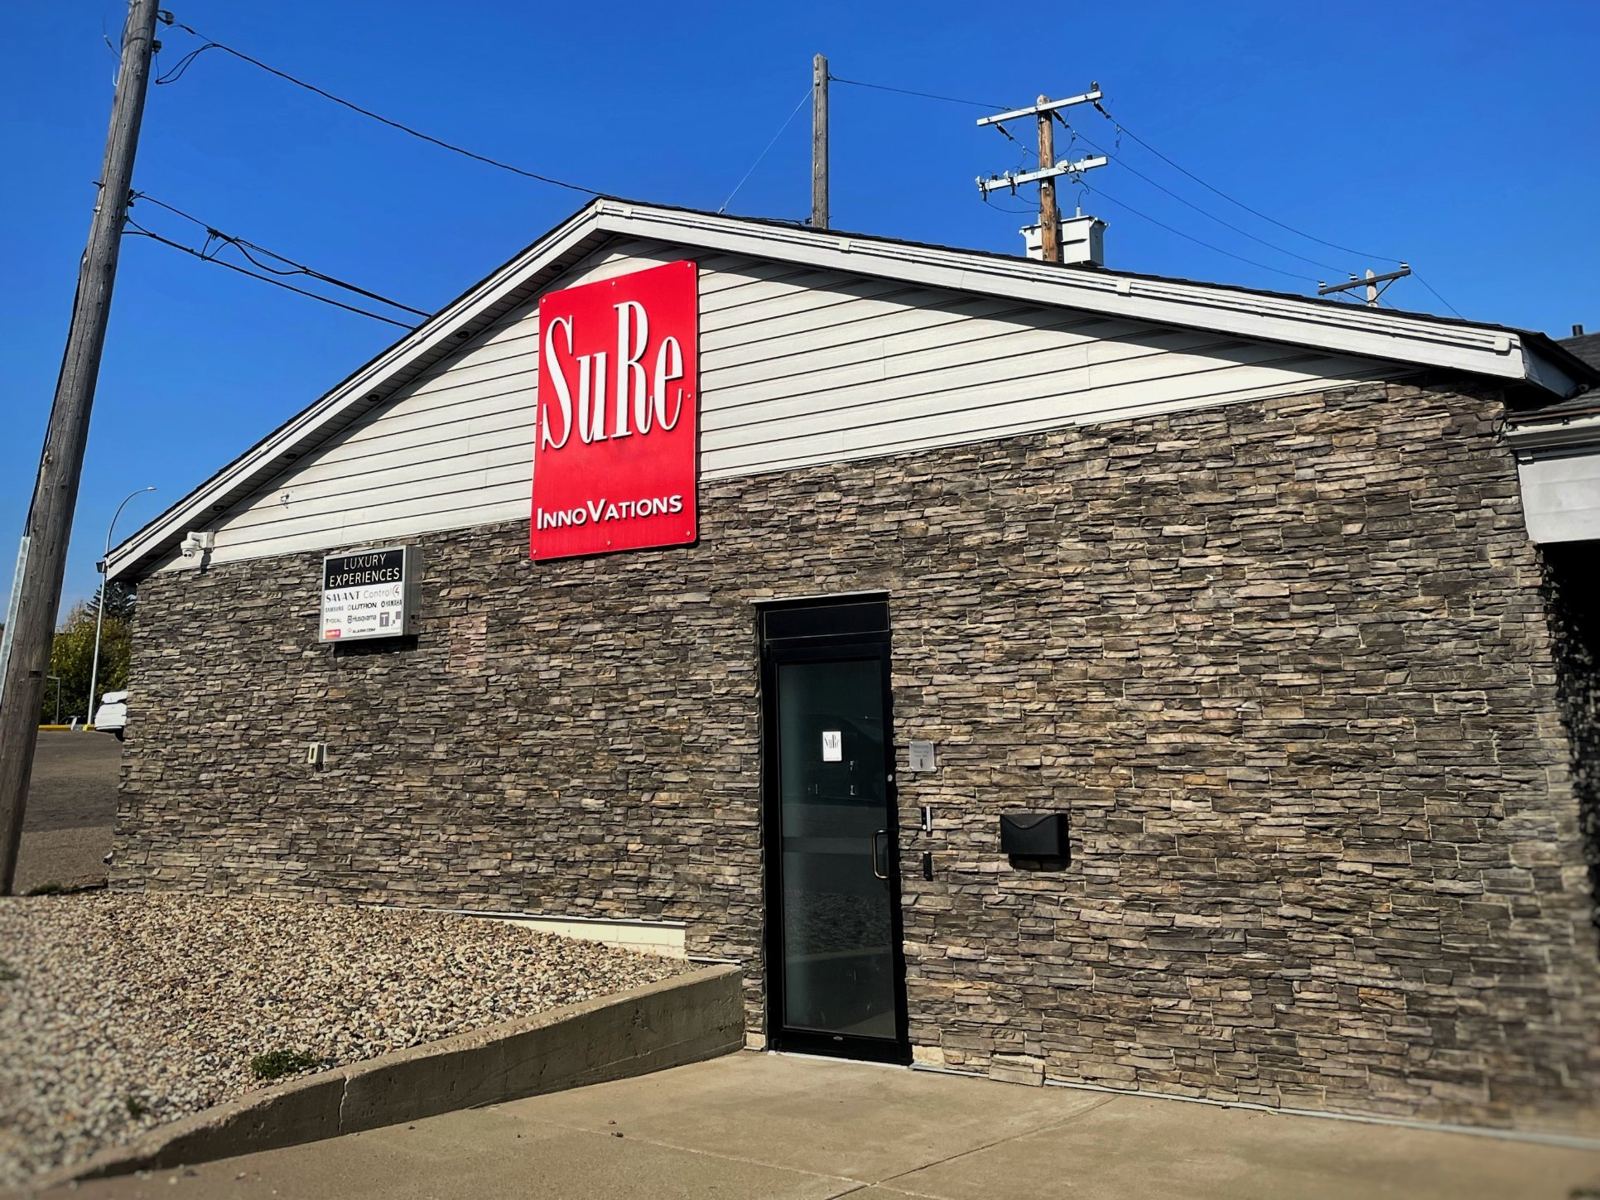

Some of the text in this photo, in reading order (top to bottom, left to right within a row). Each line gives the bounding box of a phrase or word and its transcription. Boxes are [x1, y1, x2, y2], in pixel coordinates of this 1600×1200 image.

[541, 300, 684, 451] SuRe
[343, 553, 387, 571] LUXURY
[329, 567, 400, 588] EXPERIENCES
